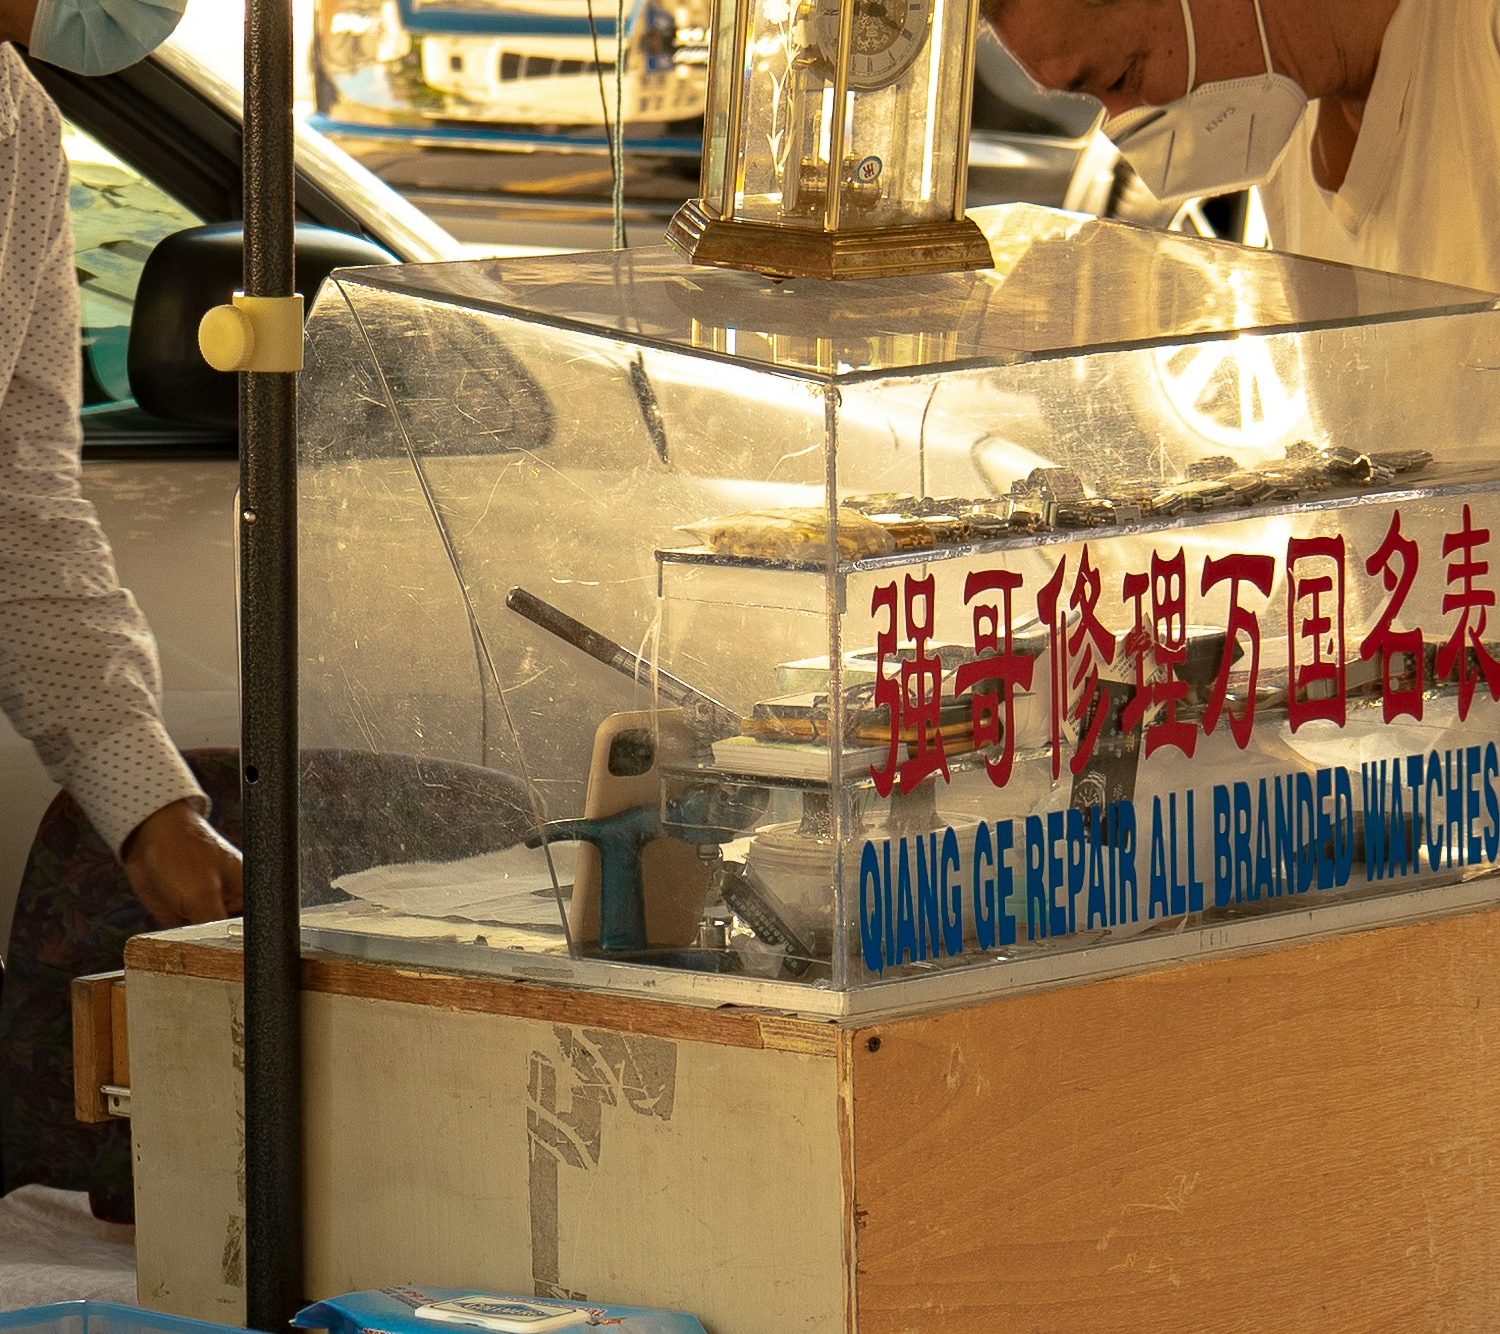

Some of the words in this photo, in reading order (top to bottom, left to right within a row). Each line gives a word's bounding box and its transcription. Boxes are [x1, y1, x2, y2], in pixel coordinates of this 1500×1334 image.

[858, 825, 962, 979] QIANG
[973, 819, 1018, 955] GE
[1026, 795, 1138, 942] REPAIR
[1148, 788, 1203, 921] ALL
[1212, 766, 1354, 908] BRANDED
